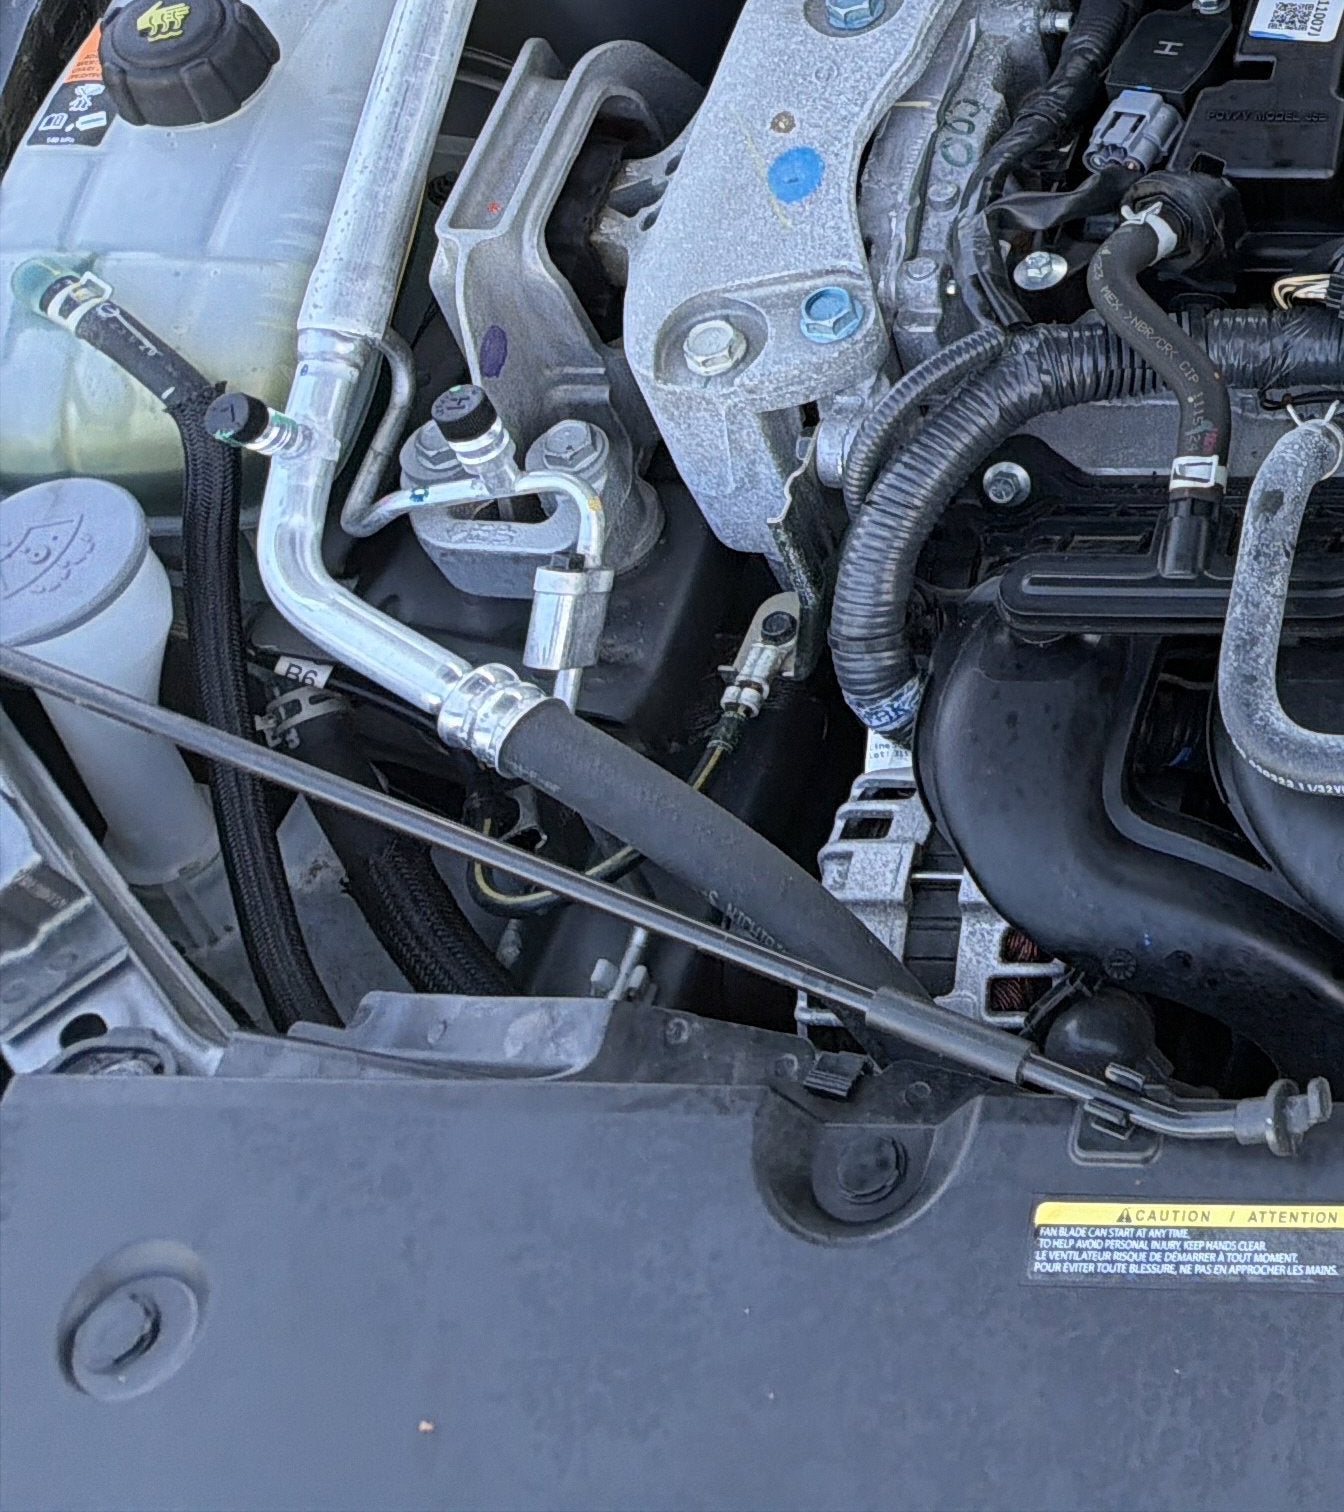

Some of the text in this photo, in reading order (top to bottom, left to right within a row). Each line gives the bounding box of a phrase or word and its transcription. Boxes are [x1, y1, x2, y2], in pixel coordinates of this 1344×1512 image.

[1100, 285, 1124, 312] MEX
[1178, 361, 1200, 383] CIP
[284, 662, 318, 686] B6
[1135, 1210, 1210, 1223] CAUTION
[1248, 1211, 1338, 1224] ATTENTION
[1039, 1227, 1057, 1239] FAN
[1059, 1227, 1086, 1239] BLADE
[1088, 1227, 1106, 1239] CAN
[1108, 1227, 1134, 1239] START
[1136, 1227, 1148, 1239] AT
[1039, 1239, 1051, 1251] TO
[1053, 1239, 1074, 1251] HELP
[1077, 1239, 1102, 1251] AVOID
[1105, 1239, 1149, 1251] PERSONAL
[1184, 1239, 1204, 1251] KEEP
[1206, 1239, 1236, 1251] HANDS
[1036, 1251, 1046, 1263] LE
[1048, 1251, 1112, 1263] VENTILATEUR
[1113, 1251, 1147, 1263] RISQUE
[1149, 1251, 1162, 1263] DE
[1227, 1251, 1252, 1263] TOUT
[1034, 1262, 1062, 1275] POUR
[1097, 1262, 1127, 1275] TOUTE
[1180, 1262, 1192, 1275] NE
[1194, 1262, 1212, 1275] PAS
[1214, 1262, 1227, 1275] EN
[1228, 1262, 1286, 1275] APPROCHER
[1287, 1262, 1304, 1275] LES
